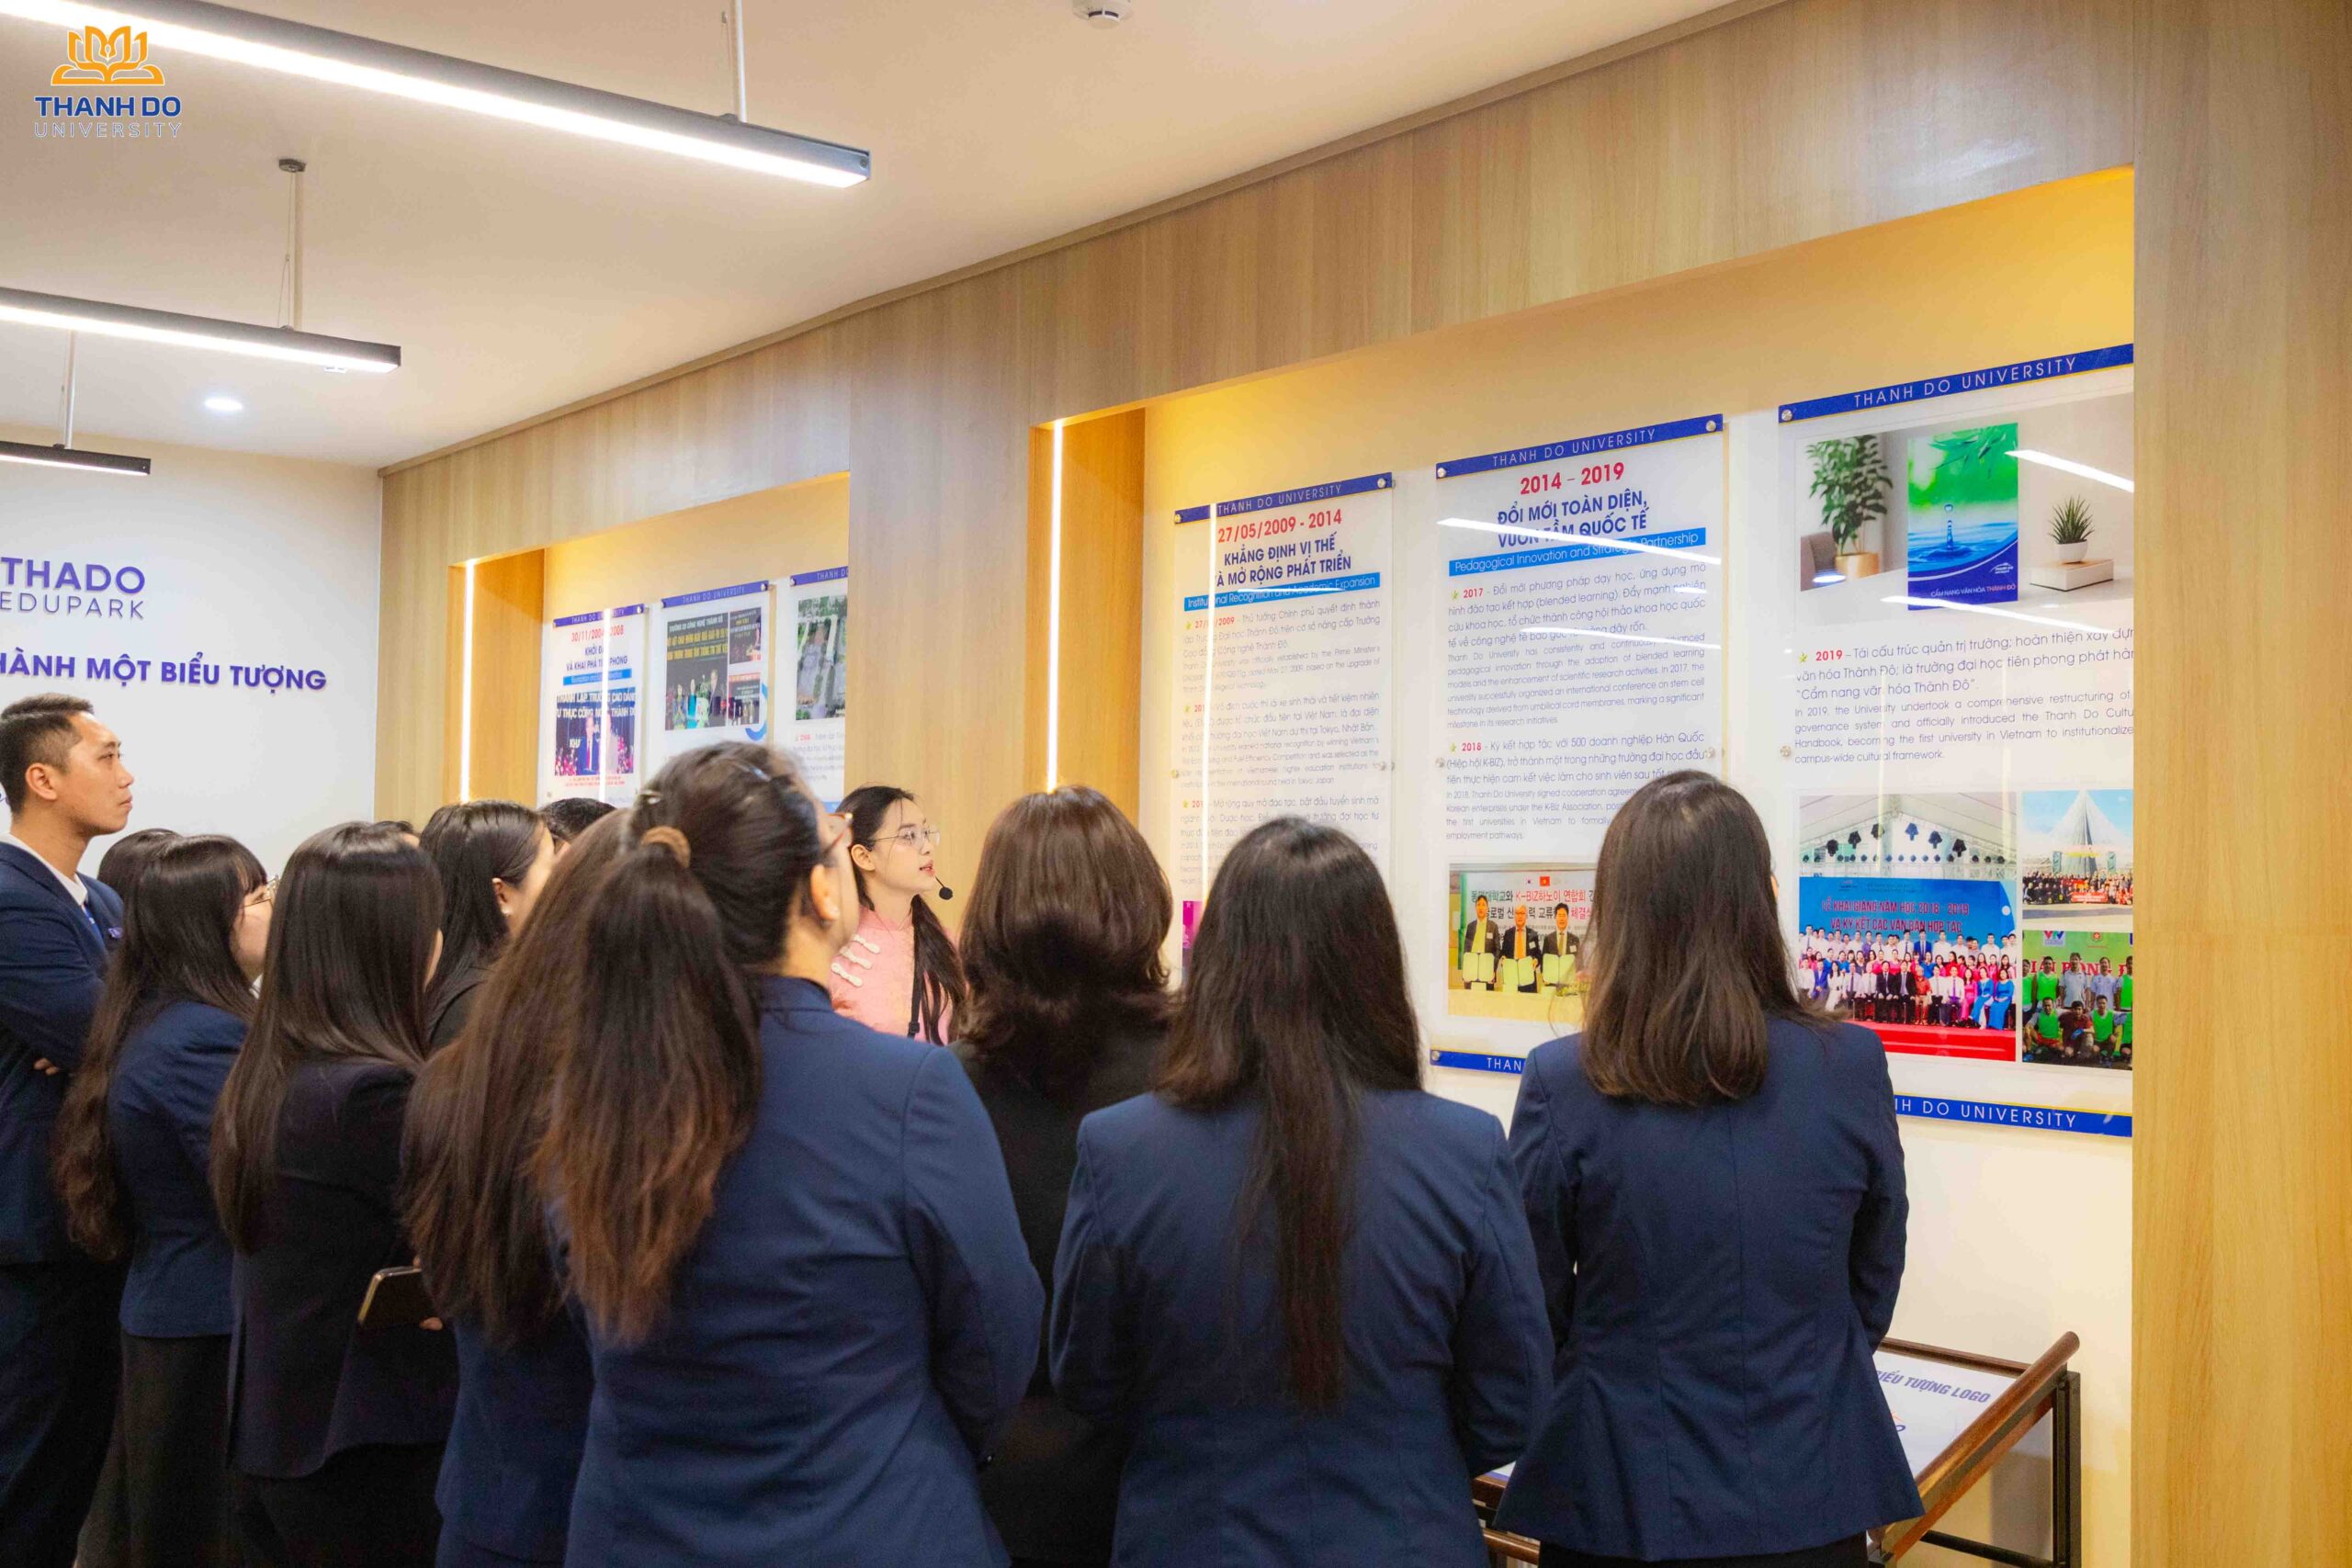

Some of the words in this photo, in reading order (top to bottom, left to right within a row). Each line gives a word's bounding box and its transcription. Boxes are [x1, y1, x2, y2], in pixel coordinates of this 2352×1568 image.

[1854, 388, 1914, 408] THANH
[1925, 380, 1950, 396] DO
[1962, 357, 2076, 389] UNIVERSITY
[1493, 450, 1537, 467] THANH
[1544, 446, 1564, 458] DO
[1573, 428, 1655, 454] UNIVERSITY
[1521, 472, 1561, 494] 2014
[1581, 462, 1624, 485] 2019
[1218, 499, 1251, 515] THANH
[1258, 495, 1272, 506] DO
[1278, 484, 1341, 505] UNIVERSITY
[1498, 502, 1523, 525] ĐỔI
[1529, 501, 1557, 521] MỚI
[1562, 494, 1603, 515] TOÀN
[1608, 489, 1647, 511] DIỆN,
[1218, 516, 1296, 543] 27/05/2009
[1308, 509, 1341, 529] 2014
[1579, 515, 1626, 536] QUỐC
[1632, 507, 1649, 529] TẾ
[1224, 544, 1264, 566] KHẲNG
[1268, 544, 1295, 561] ĐỊNH
[1300, 543, 1311, 558] VỊ
[1315, 531, 1337, 551] THẾ
[1455, 556, 1514, 571] Pedagogical
[1517, 550, 1566, 564] Innovation
[1570, 547, 1589, 557] and
[1, 557, 145, 594] THADO
[1250, 567, 1283, 588] RỘNG
[1287, 558, 1316, 578] PHÁT
[1320, 550, 1351, 572] TRIỂN
[1188, 594, 1227, 608] Institunal
[1336, 577, 1375, 590] Expansion
[1464, 588, 1483, 598] 2017
[1530, 581, 1563, 592] phương
[1566, 575, 1590, 588] pháp
[0, 591, 143, 620] EDUPARK
[1195, 617, 1235, 628] 27//2009
[1465, 620, 1486, 629] khoa
[1815, 650, 1842, 660] 2019
[1854, 648, 1869, 659] Tái
[1871, 645, 1894, 658] cấu
[1897, 643, 1918, 656] trúc
[1922, 640, 1952, 654] quản
[2016, 636, 2048, 648] hoàn
[2052, 631, 2083, 644] thiện
[87, 653, 151, 687] MỘT
[162, 652, 220, 685] BIỂU
[231, 664, 326, 694] TƯỢNG
[1796, 671, 1815, 682] văn
[1819, 669, 1840, 681] hóa
[1844, 666, 1876, 679] Thành
[1903, 663, 1912, 674] là
[1917, 661, 1954, 673] trường
[1980, 659, 2003, 671] học
[2007, 656, 2029, 667] tiên
[2033, 654, 2075, 668] phong
[2079, 649, 2109, 663] phát
[1831, 689, 1860, 699] nang
[1888, 683, 1910, 694] hóa
[1914, 681, 1949, 693] Thành
[1836, 705, 1849, 715] the
[1902, 700, 1949, 712] undertook
[2050, 692, 2113, 703] restructuring
[2120, 690, 2132, 699] of
[1795, 723, 1849, 734] governance
[1892, 719, 1910, 728] and
[1917, 716, 1955, 728] officially
[1962, 713, 2015, 725] introduced
[2022, 712, 2039, 721] the
[2045, 711, 2076, 721] Thanh
[2084, 709, 2098, 719] Do
[1795, 739, 1842, 748] Handbook,
[1900, 735, 1914, 743] the
[1918, 733, 1933, 742] first
[1986, 731, 1995, 739] in
[2000, 729, 2041, 739] Vietnam
[2047, 729, 2057, 738] to
[1795, 754, 1854, 764] campus-wide
[1487, 1057, 1522, 1071] THAN
[1923, 1100, 1949, 1116] DO
[1962, 1104, 2076, 1128] UNIVERSITY
[1905, 1377, 1951, 1394] TƯỢNG
[1951, 1387, 1991, 1403] LOGO
